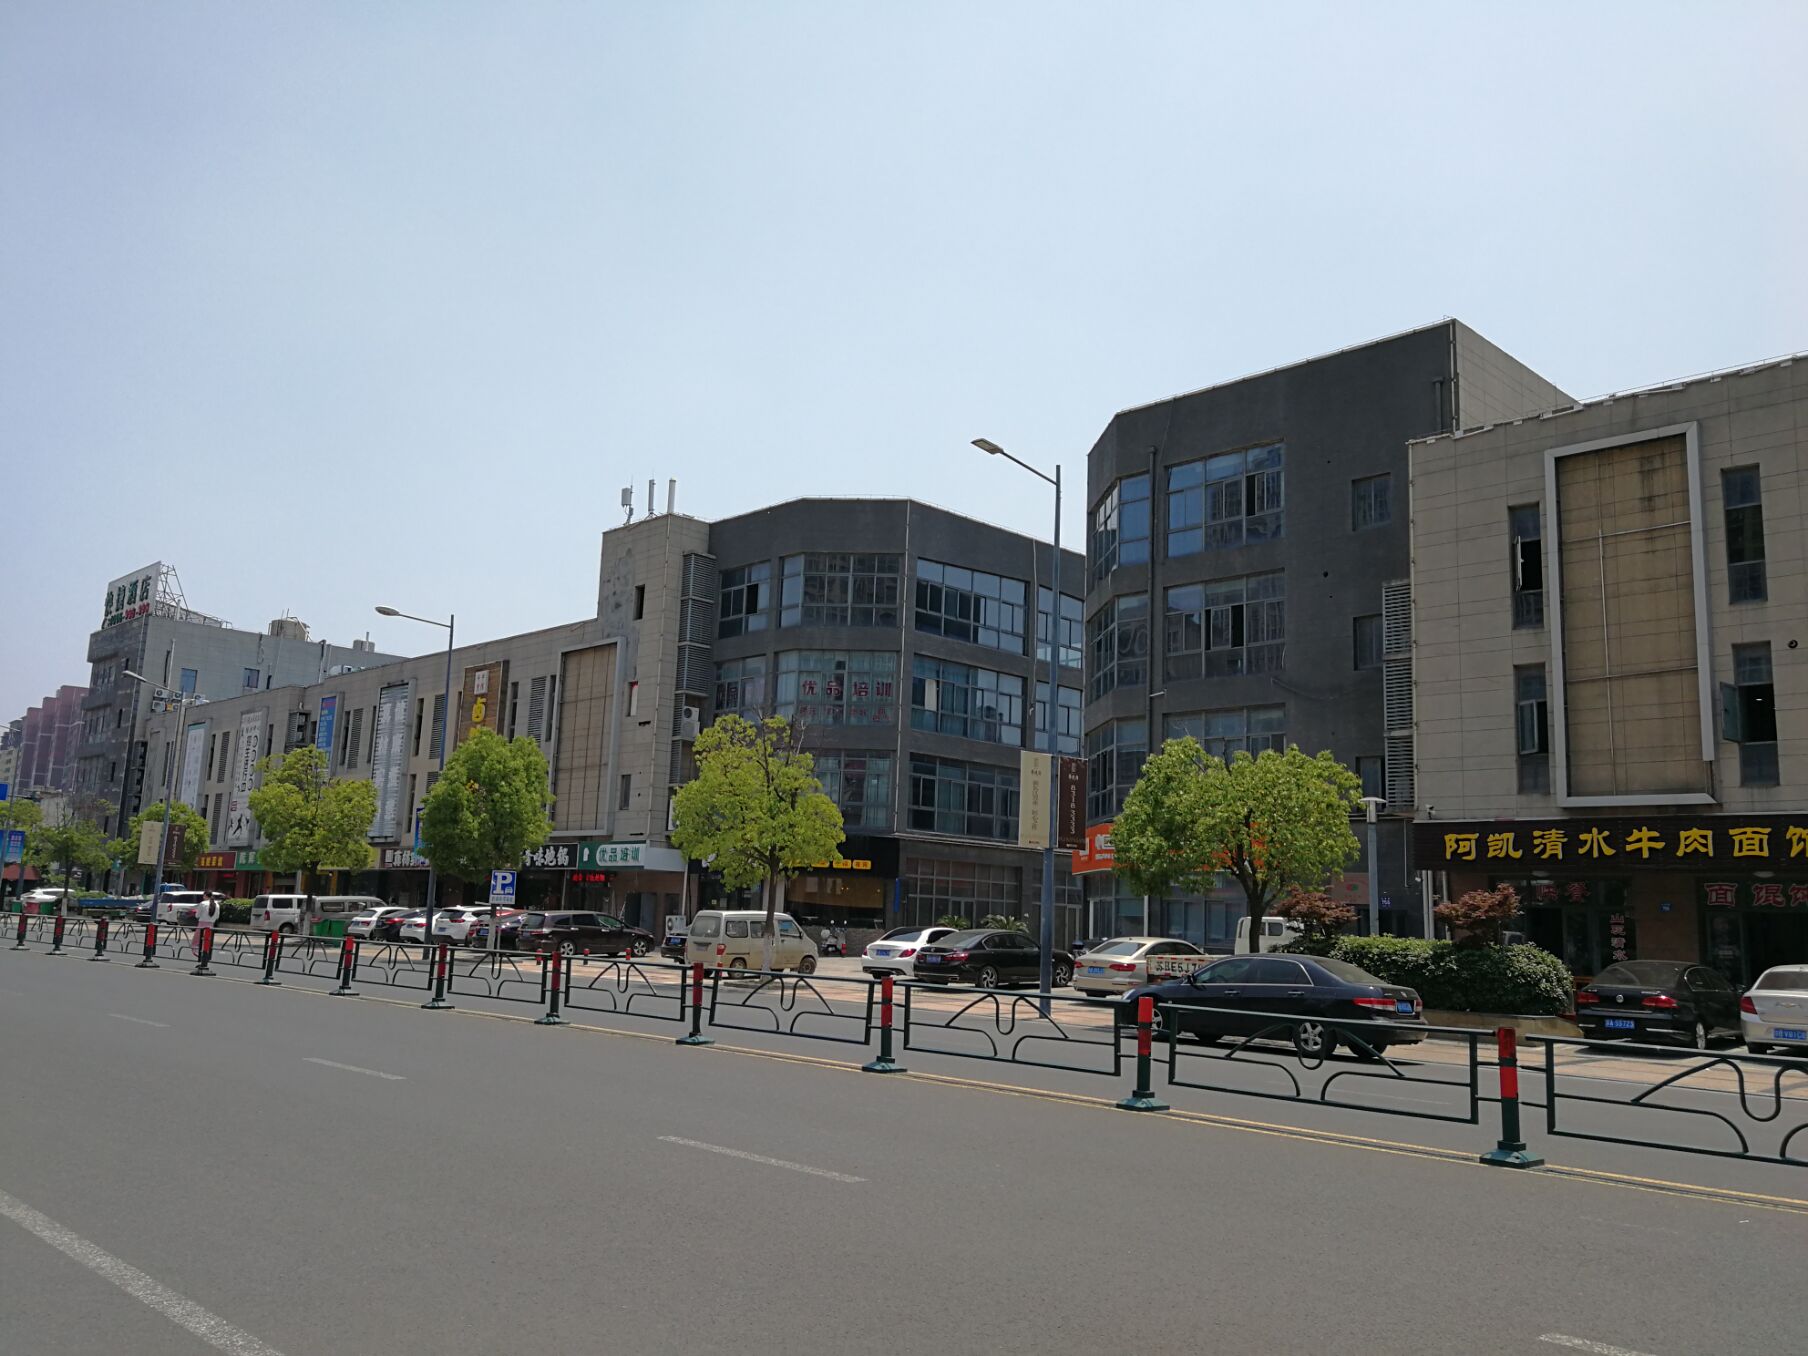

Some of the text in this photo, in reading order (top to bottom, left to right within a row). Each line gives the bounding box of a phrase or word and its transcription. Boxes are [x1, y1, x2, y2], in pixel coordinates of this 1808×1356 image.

[802, 680, 893, 698] 优品培训
[599, 846, 641, 863] 优品培训
[493, 872, 513, 894] P
